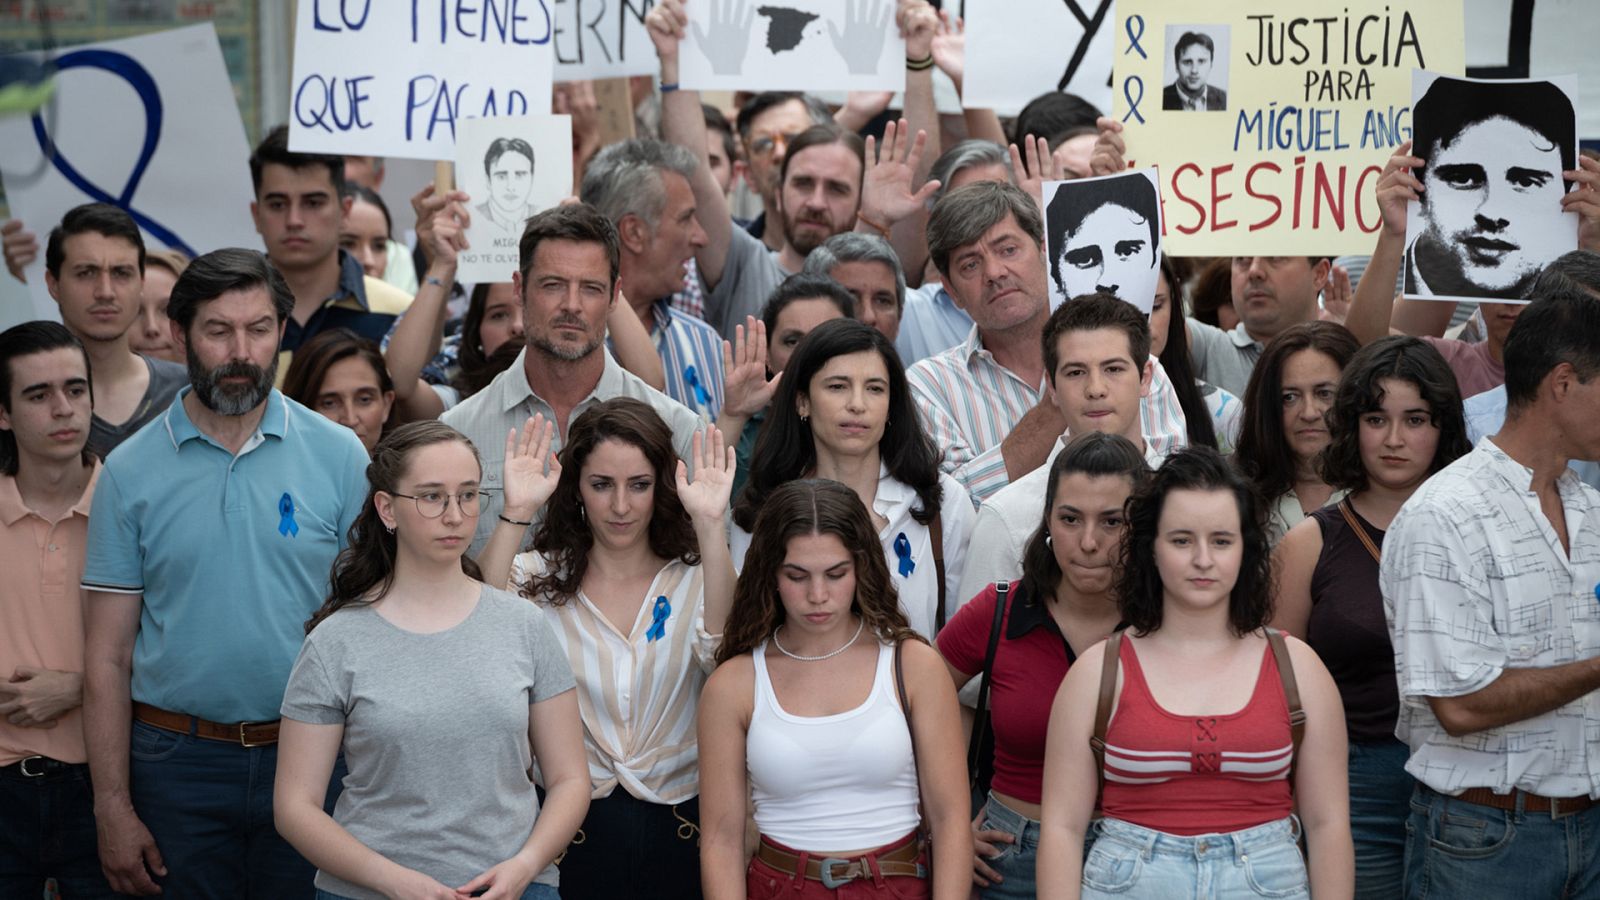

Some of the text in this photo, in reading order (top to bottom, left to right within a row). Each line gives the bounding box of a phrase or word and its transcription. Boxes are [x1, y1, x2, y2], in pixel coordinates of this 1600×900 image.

[1246, 5, 1426, 70] JUSTICIA
[294, 74, 374, 133] QUE
[1303, 68, 1375, 101] PARA
[1233, 101, 1350, 152] MIGUEL
[462, 253, 478, 264] NO
[480, 253, 492, 264] TE
